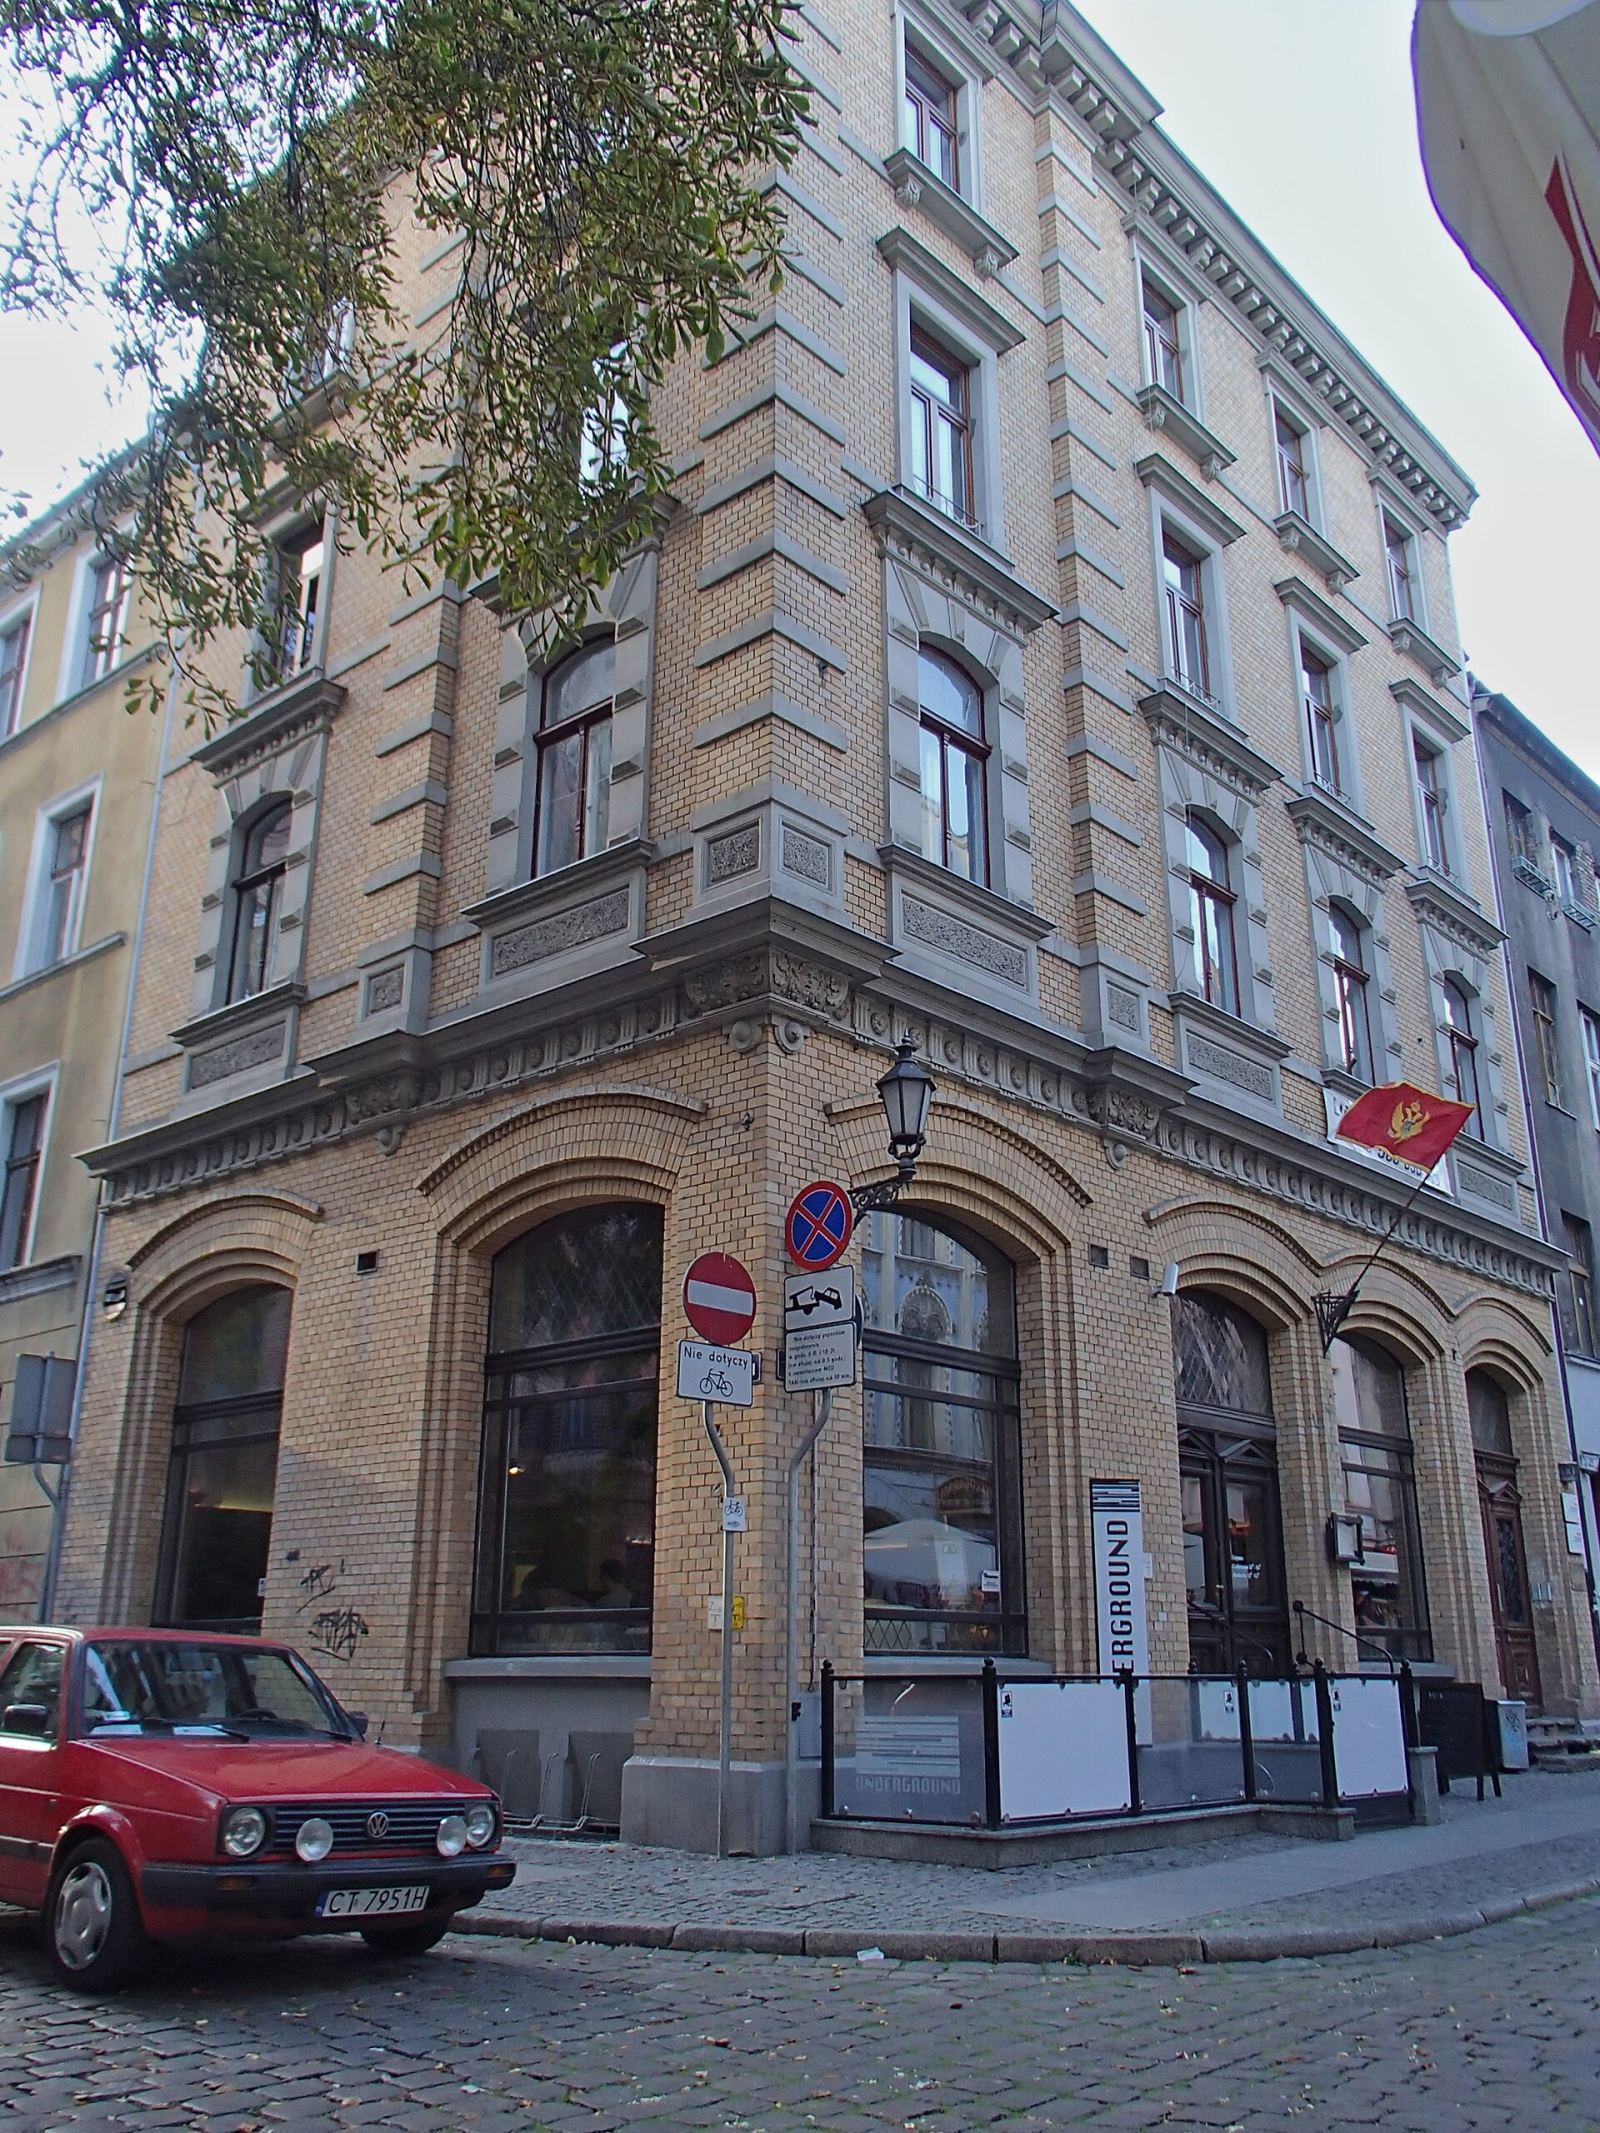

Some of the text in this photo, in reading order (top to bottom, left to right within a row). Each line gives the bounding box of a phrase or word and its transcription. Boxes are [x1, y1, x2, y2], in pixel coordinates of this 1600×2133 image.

[684, 1345, 703, 1360] Nie
[708, 1350, 748, 1370] dotyczy
[1107, 1520, 1134, 1675] ERGROUND
[854, 1776, 961, 1796] UNDERGROUND
[329, 1886, 427, 1914] CT 7951H
